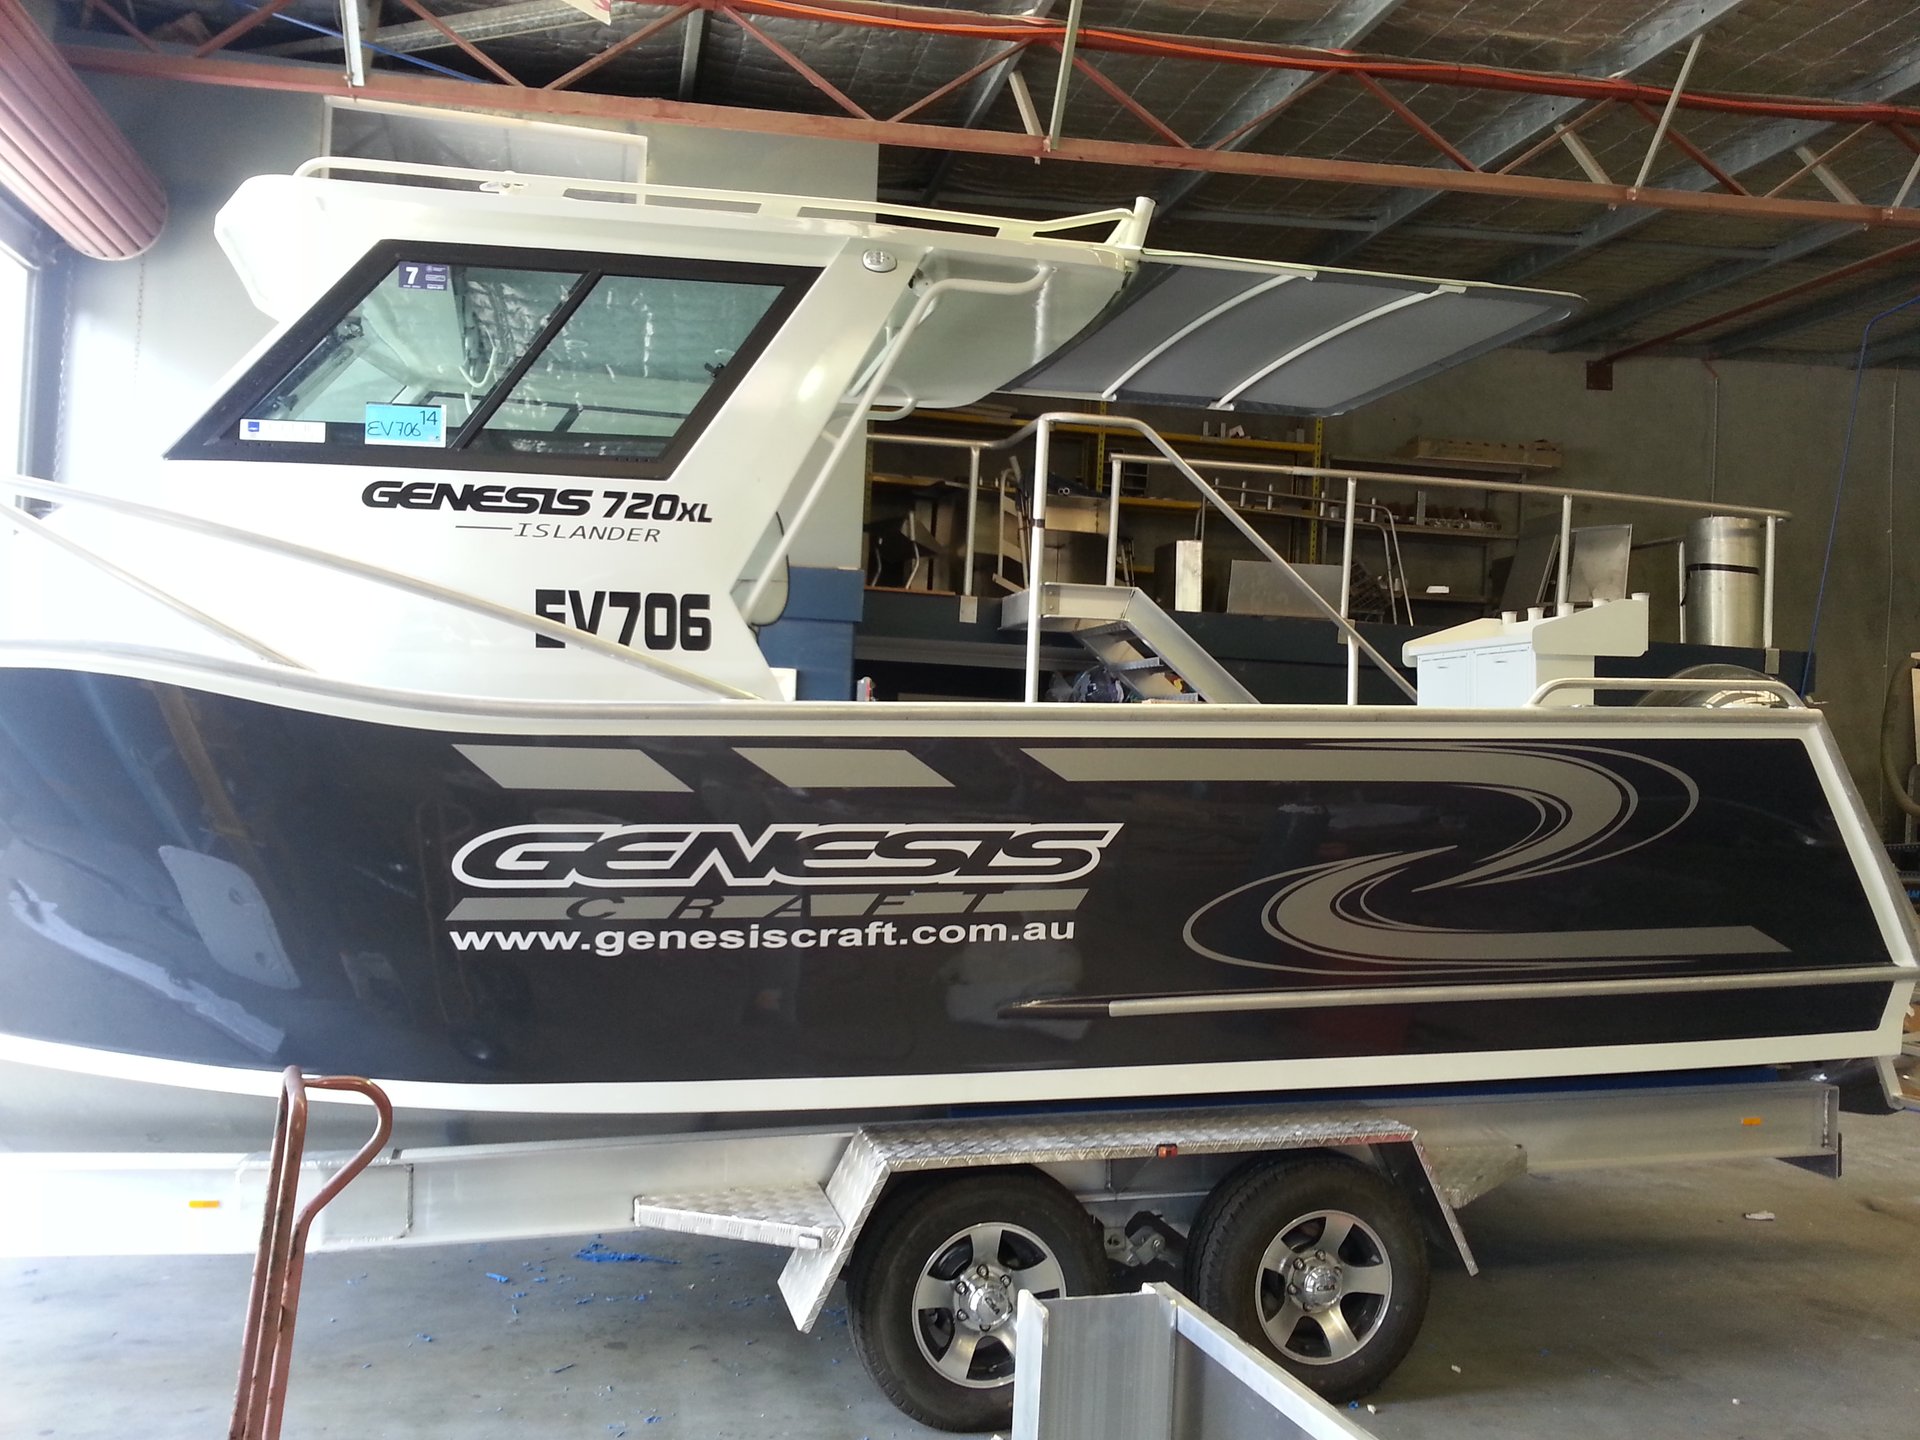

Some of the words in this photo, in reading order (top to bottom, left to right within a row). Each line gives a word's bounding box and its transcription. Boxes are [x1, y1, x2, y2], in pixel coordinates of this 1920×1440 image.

[405, 266, 419, 285] 7
[367, 420, 422, 437] EV706
[420, 410, 439, 426] 14
[362, 480, 594, 517] GENESIS
[603, 491, 713, 523] 720XL
[514, 522, 661, 543] ISLANDER
[535, 588, 712, 651] EV706
[451, 822, 1125, 889] GENESIS
[565, 890, 1005, 919] CRAFT
[449, 920, 1076, 957] www.genesiscraft.com.au
